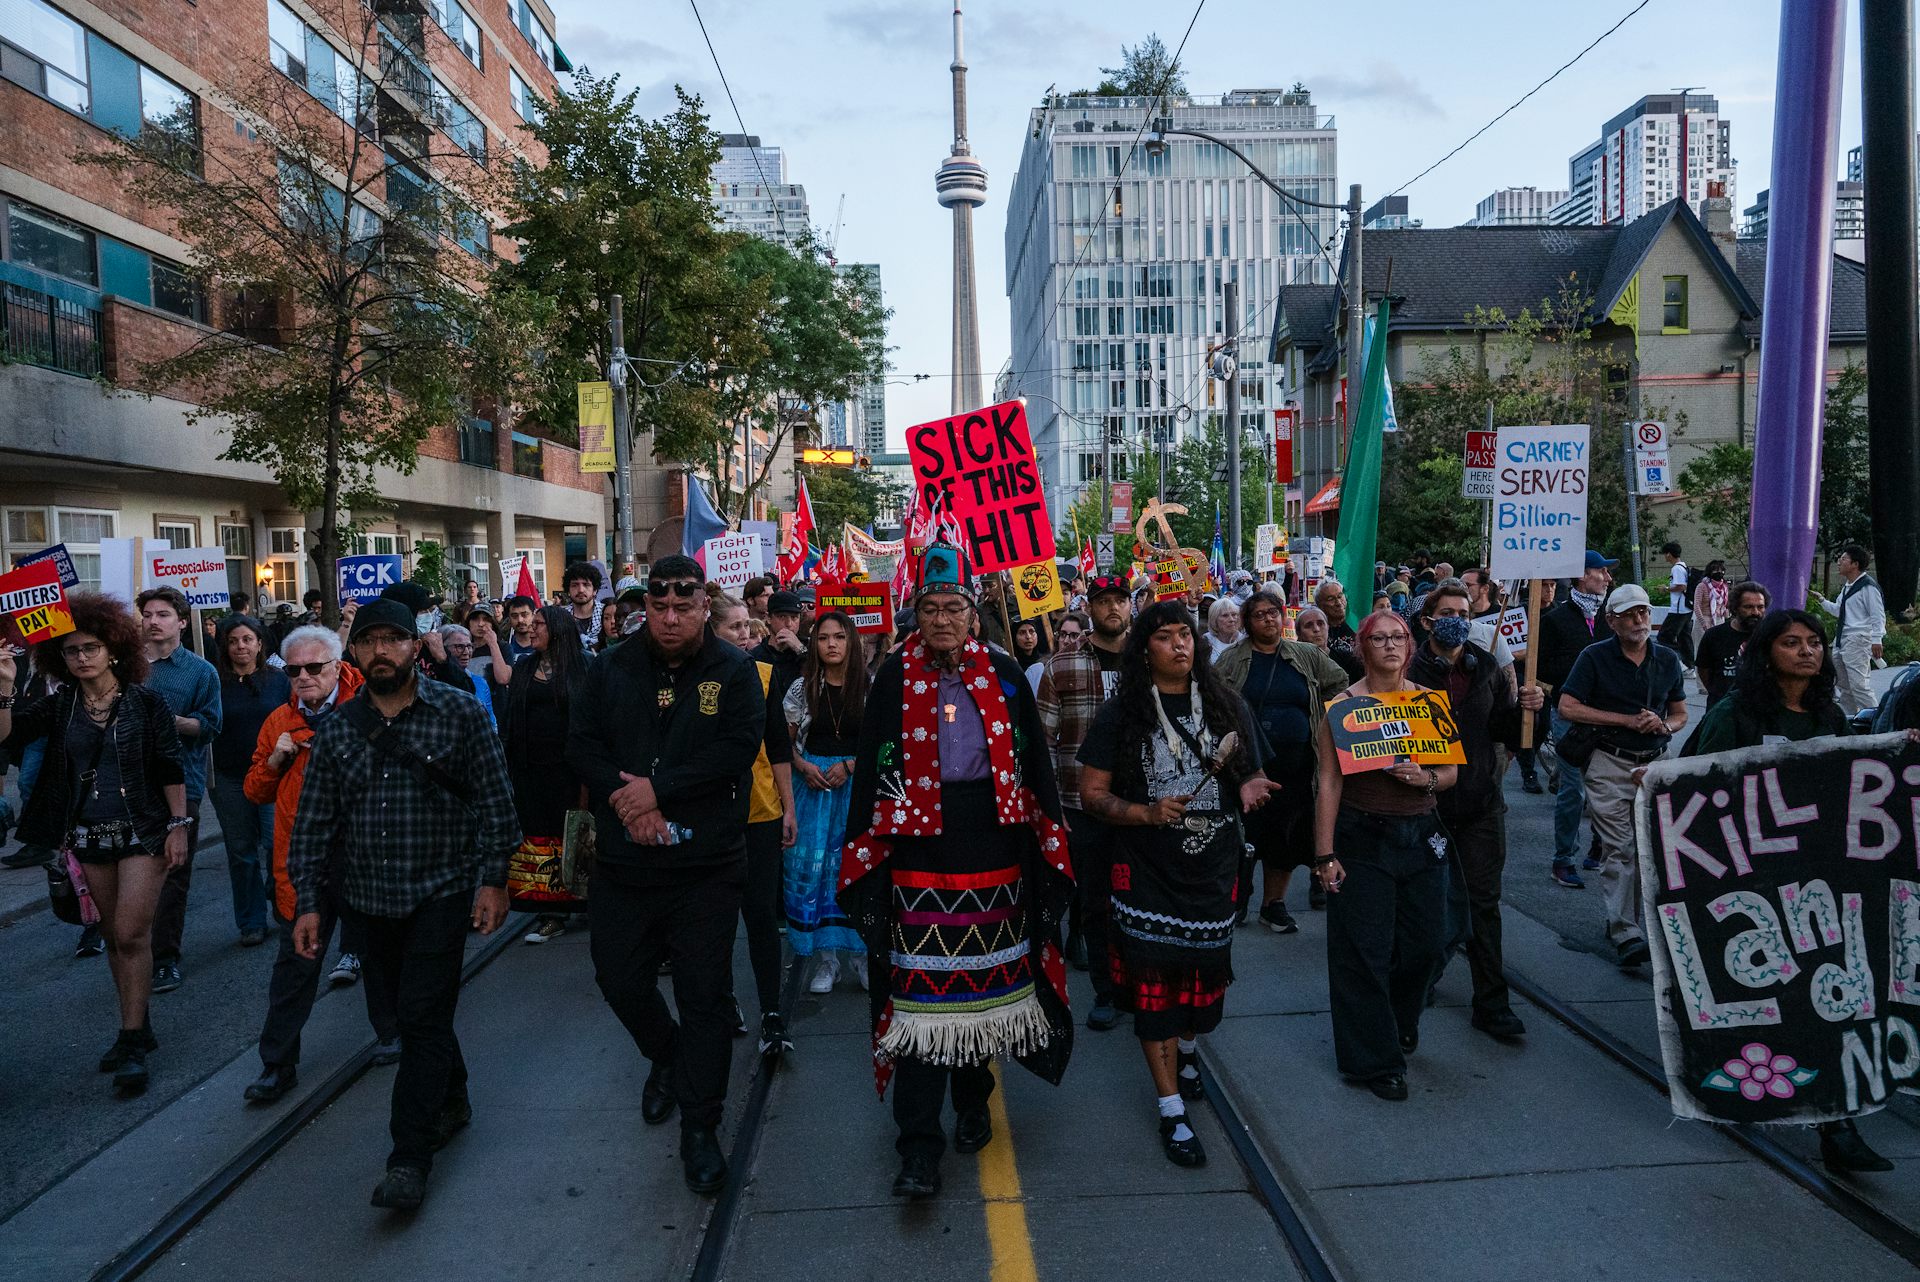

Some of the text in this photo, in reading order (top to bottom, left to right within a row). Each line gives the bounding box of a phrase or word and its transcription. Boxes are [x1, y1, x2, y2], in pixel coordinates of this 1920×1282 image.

[915, 406, 1027, 479] SICK
[1506, 441, 1585, 463] CARNEY
[1640, 459, 1667, 468] STANDING
[923, 460, 1037, 515] OF THIS
[1500, 468, 1586, 496] SERVES
[1498, 502, 1582, 531] Billion-
[710, 536, 755, 551] FIGHT
[1503, 532, 1562, 552] aires
[717, 549, 750, 561] GHG
[153, 558, 225, 577] Ecosocialism
[719, 561, 750, 573] NOT
[1156, 563, 1167, 573] NO
[181, 576, 199, 588] or
[1171, 572, 1182, 581] ON
[185, 591, 229, 606] barism
[821, 596, 882, 606] TAX THEIR BILLIONS
[20, 608, 50, 634] PAY
[856, 614, 881, 625] FUTURE
[1486, 612, 1524, 626] FUURE
[1500, 620, 1525, 637] OT
[1506, 634, 1528, 646] ALE
[1354, 705, 1430, 724] NO PIPELINES
[1382, 720, 1410, 737] ON A
[1353, 739, 1448, 759] BURNING PLANET
